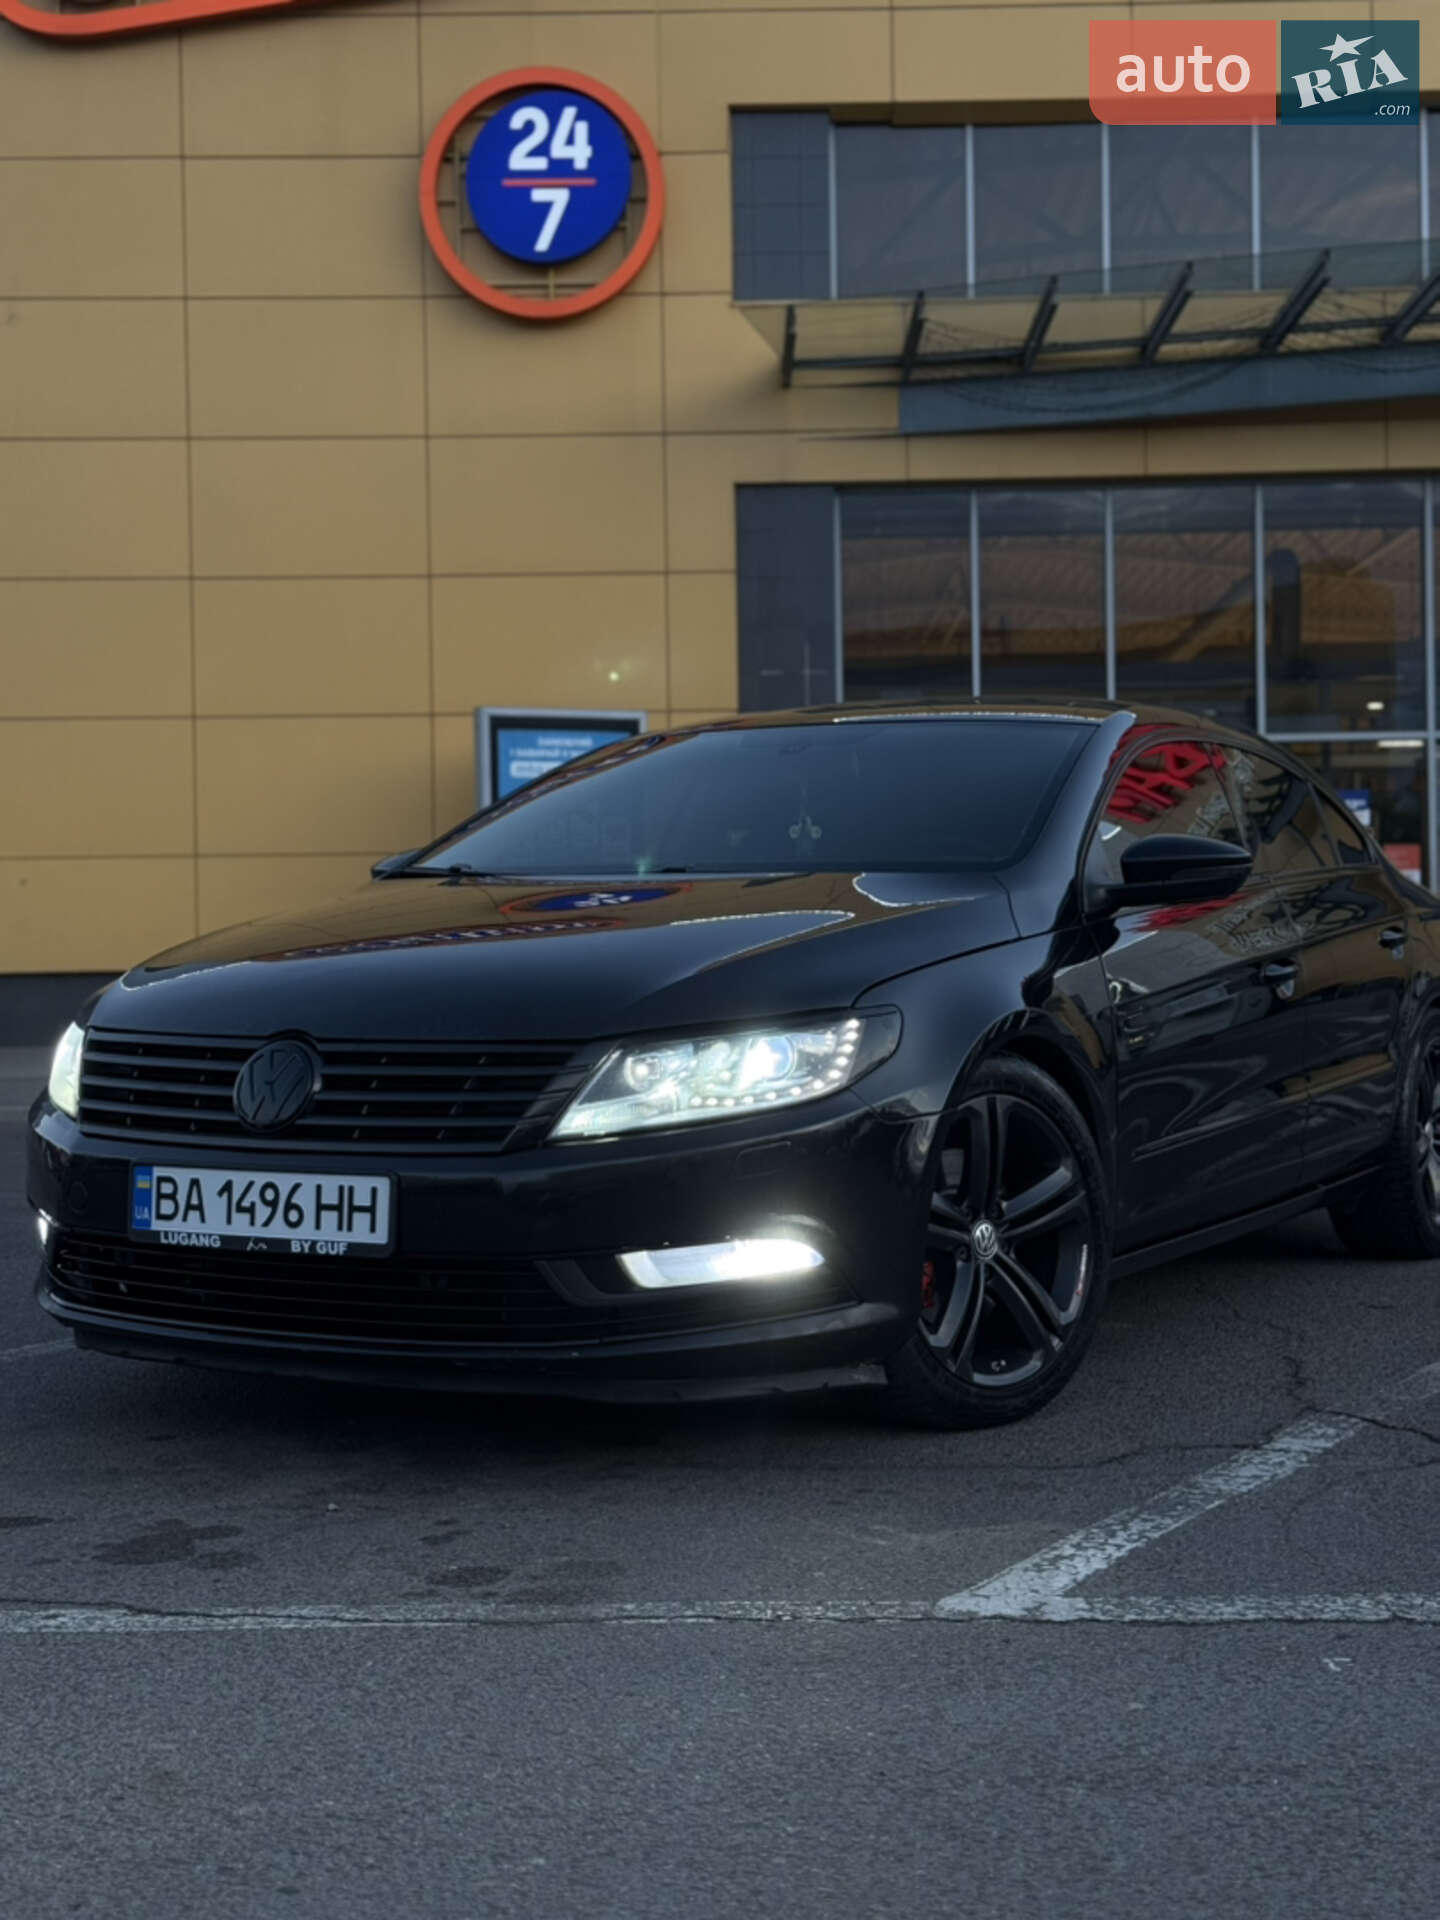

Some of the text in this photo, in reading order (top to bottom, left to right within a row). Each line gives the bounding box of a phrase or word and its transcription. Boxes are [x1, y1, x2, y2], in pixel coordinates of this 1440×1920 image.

[508, 105, 593, 171] 24
[530, 187, 571, 253] 7
[134, 1206, 151, 1222] UA
[155, 1175, 378, 1234] BA 1496 HH
[159, 1231, 349, 1256] LUGANG BY GUF
